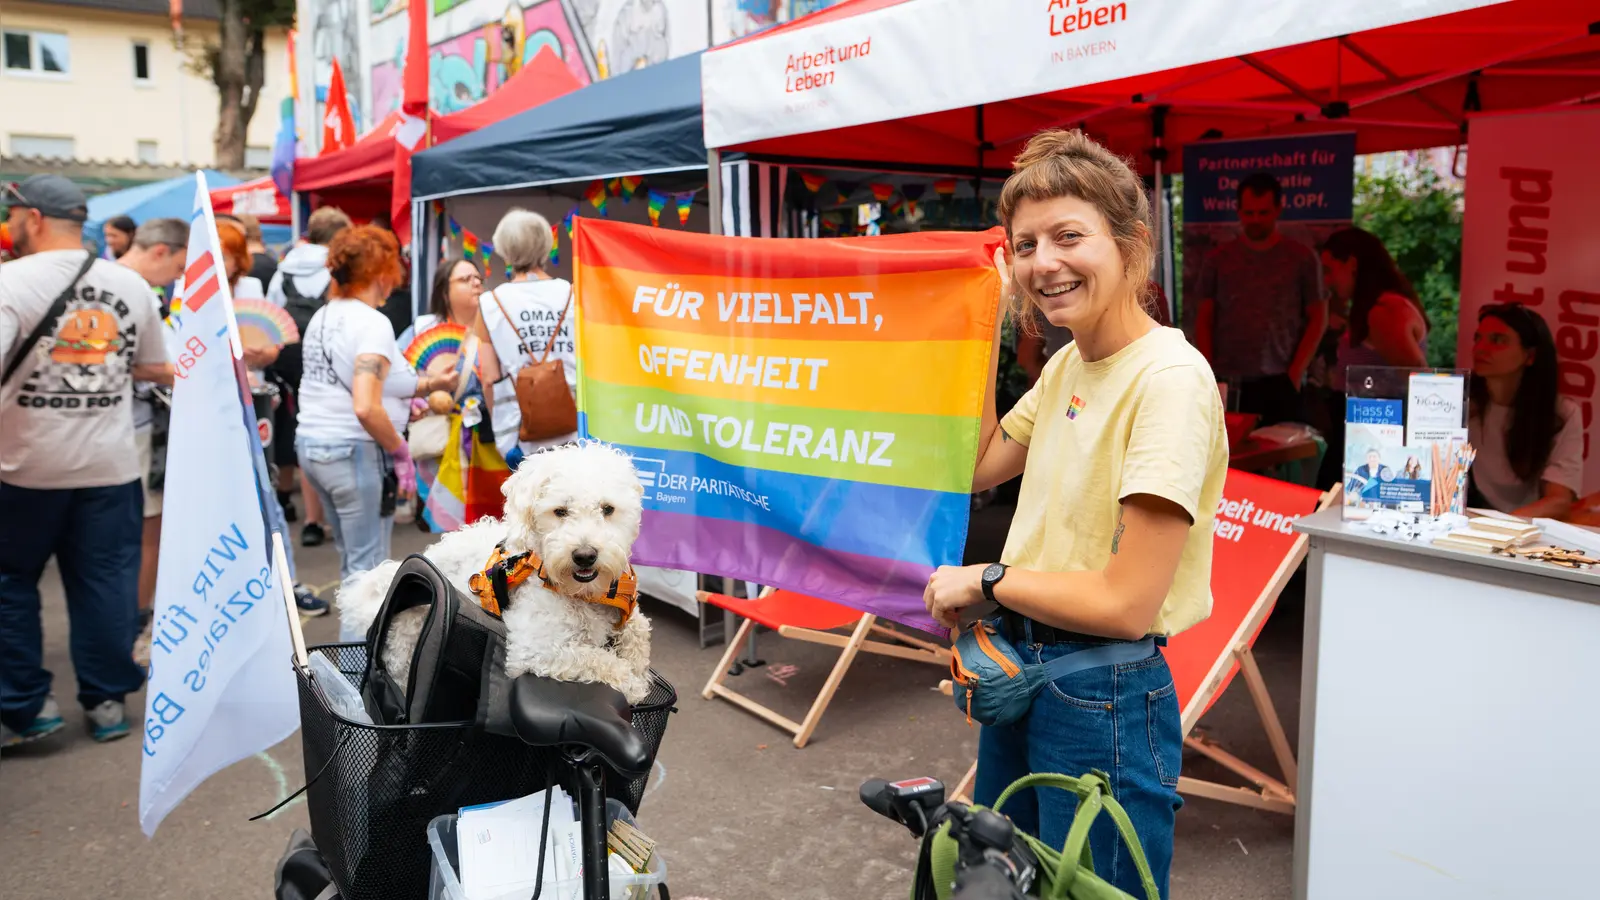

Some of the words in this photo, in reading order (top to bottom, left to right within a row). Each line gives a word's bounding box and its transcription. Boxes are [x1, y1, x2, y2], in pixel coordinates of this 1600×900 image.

[1049, 2, 1127, 37] Leben
[785, 46, 835, 75] Arbeit
[838, 36, 871, 62] und
[1051, 50, 1064, 64] IN
[1066, 40, 1117, 61] BAYERN
[785, 71, 835, 93] Leben
[1199, 152, 1306, 171] Partnerschaft
[1311, 150, 1336, 165] für
[1499, 166, 1553, 275] und
[520, 310, 566, 322] OMAS
[632, 282, 705, 321] FÜR
[717, 291, 884, 332] VIELFALT,
[638, 344, 829, 391] OFFENHEIT
[1353, 404, 1383, 417] Hass
[1385, 404, 1394, 417] &
[634, 402, 693, 438] UND
[697, 413, 895, 468] TOLERANZ
[656, 491, 687, 504] Bayern
[658, 472, 688, 491] DER
[690, 475, 772, 513] PARITÄTISCHE
[1252, 508, 1301, 536] und
